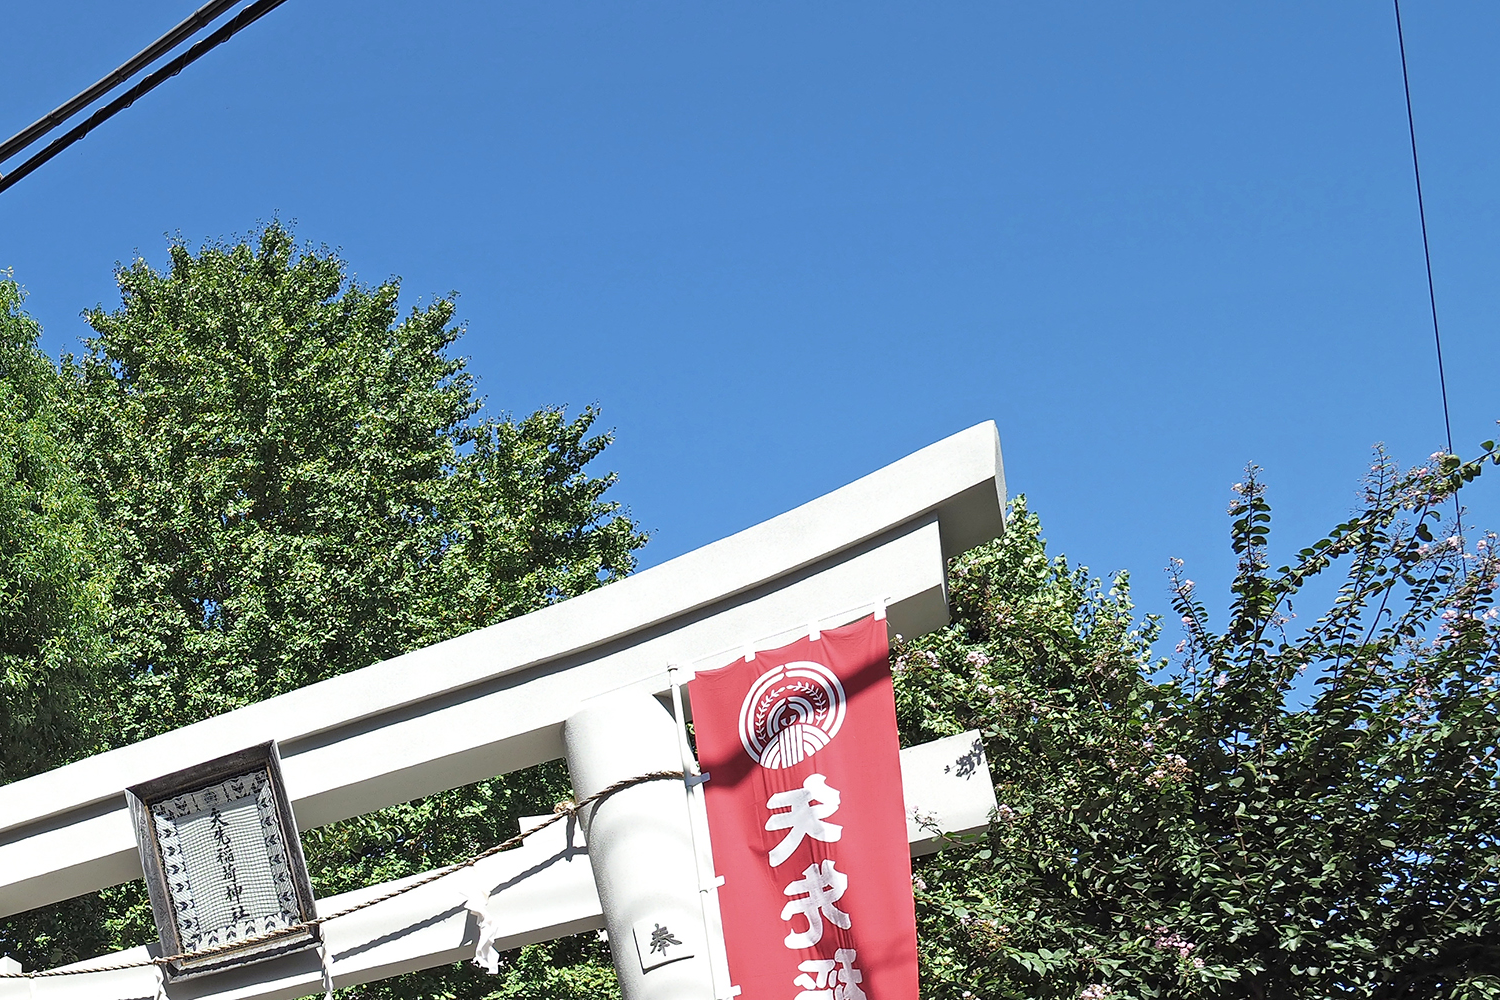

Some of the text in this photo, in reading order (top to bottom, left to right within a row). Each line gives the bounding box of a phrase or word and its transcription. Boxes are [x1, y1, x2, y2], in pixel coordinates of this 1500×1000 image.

[210, 807, 251, 924] 矢先稲荷神社
[650, 923, 682, 956] 奉
